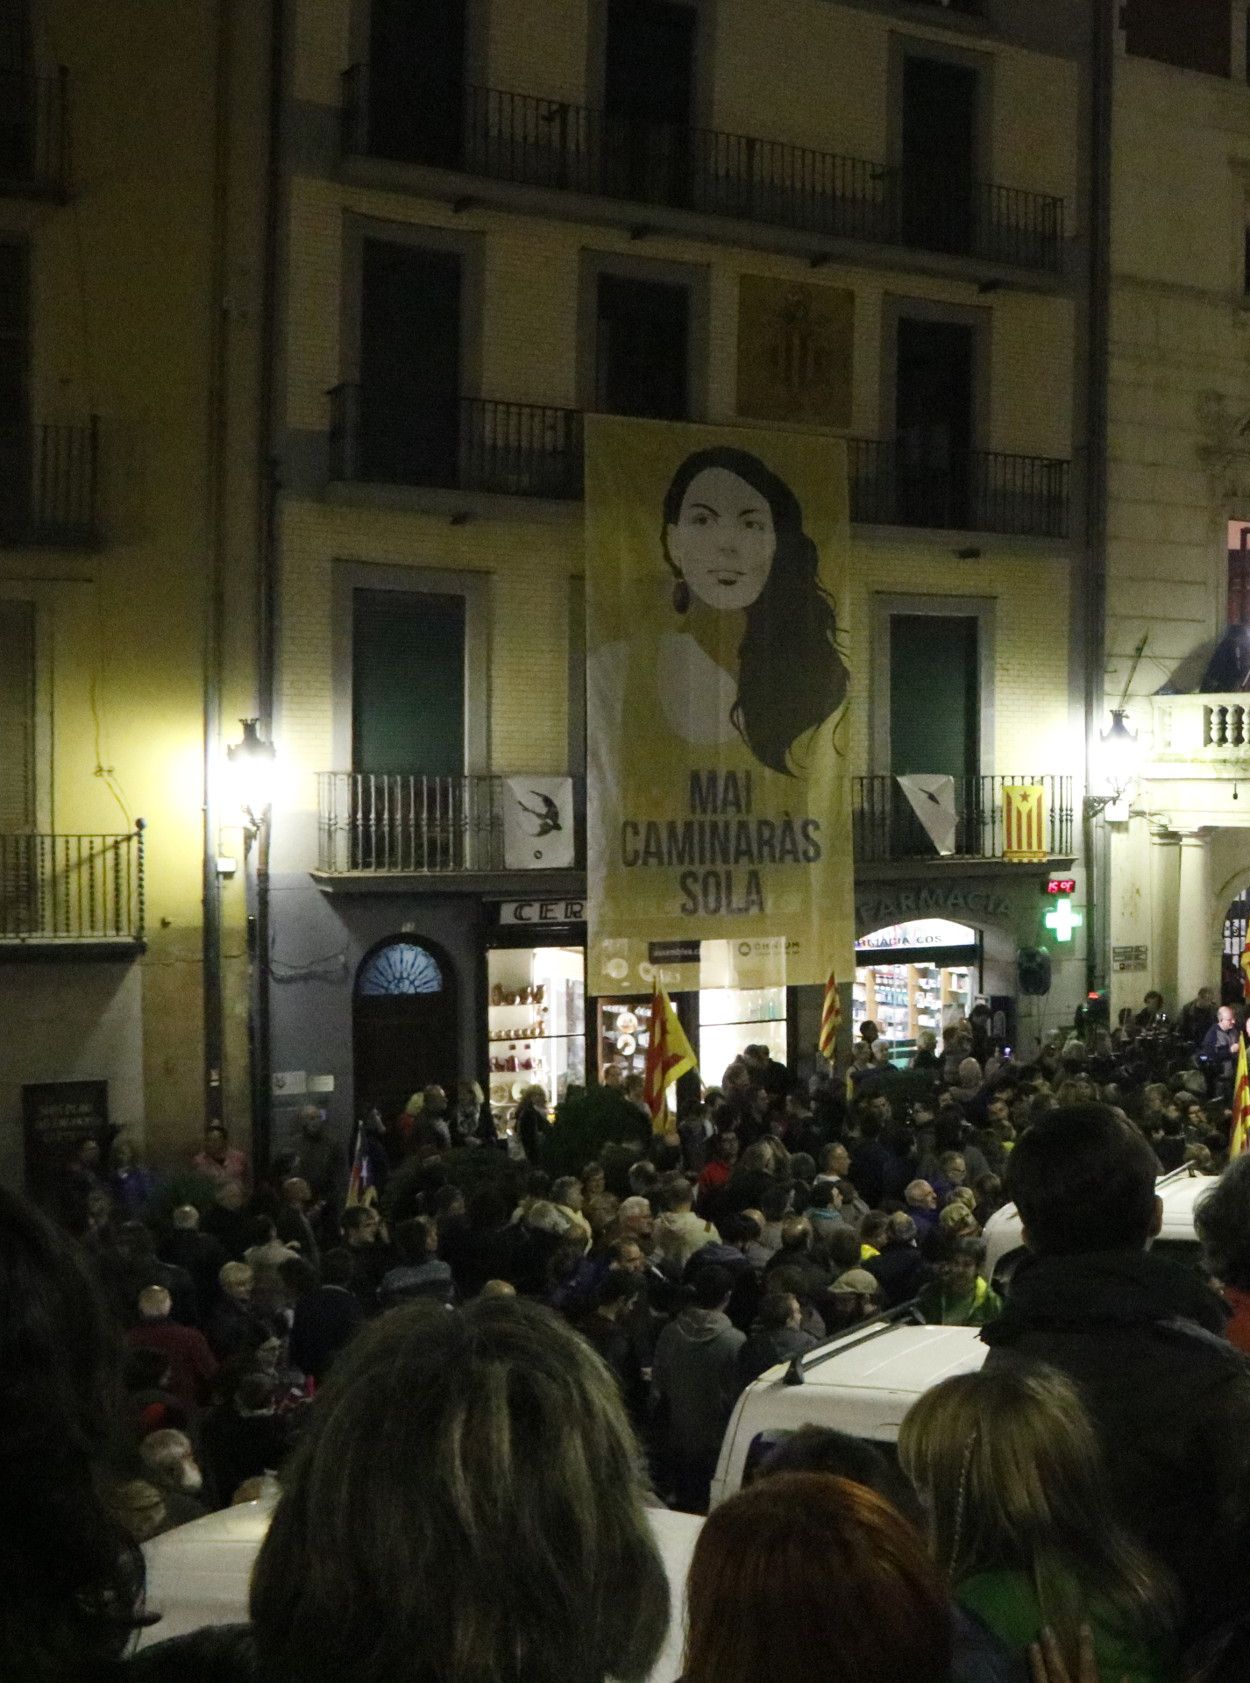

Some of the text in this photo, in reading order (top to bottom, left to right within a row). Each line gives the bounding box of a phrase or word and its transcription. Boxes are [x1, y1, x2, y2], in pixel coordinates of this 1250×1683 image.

[689, 769, 753, 814] MAI
[620, 811, 821, 867] CAMINARÀS
[513, 900, 585, 921] CER
[680, 869, 764, 916] SOLA
